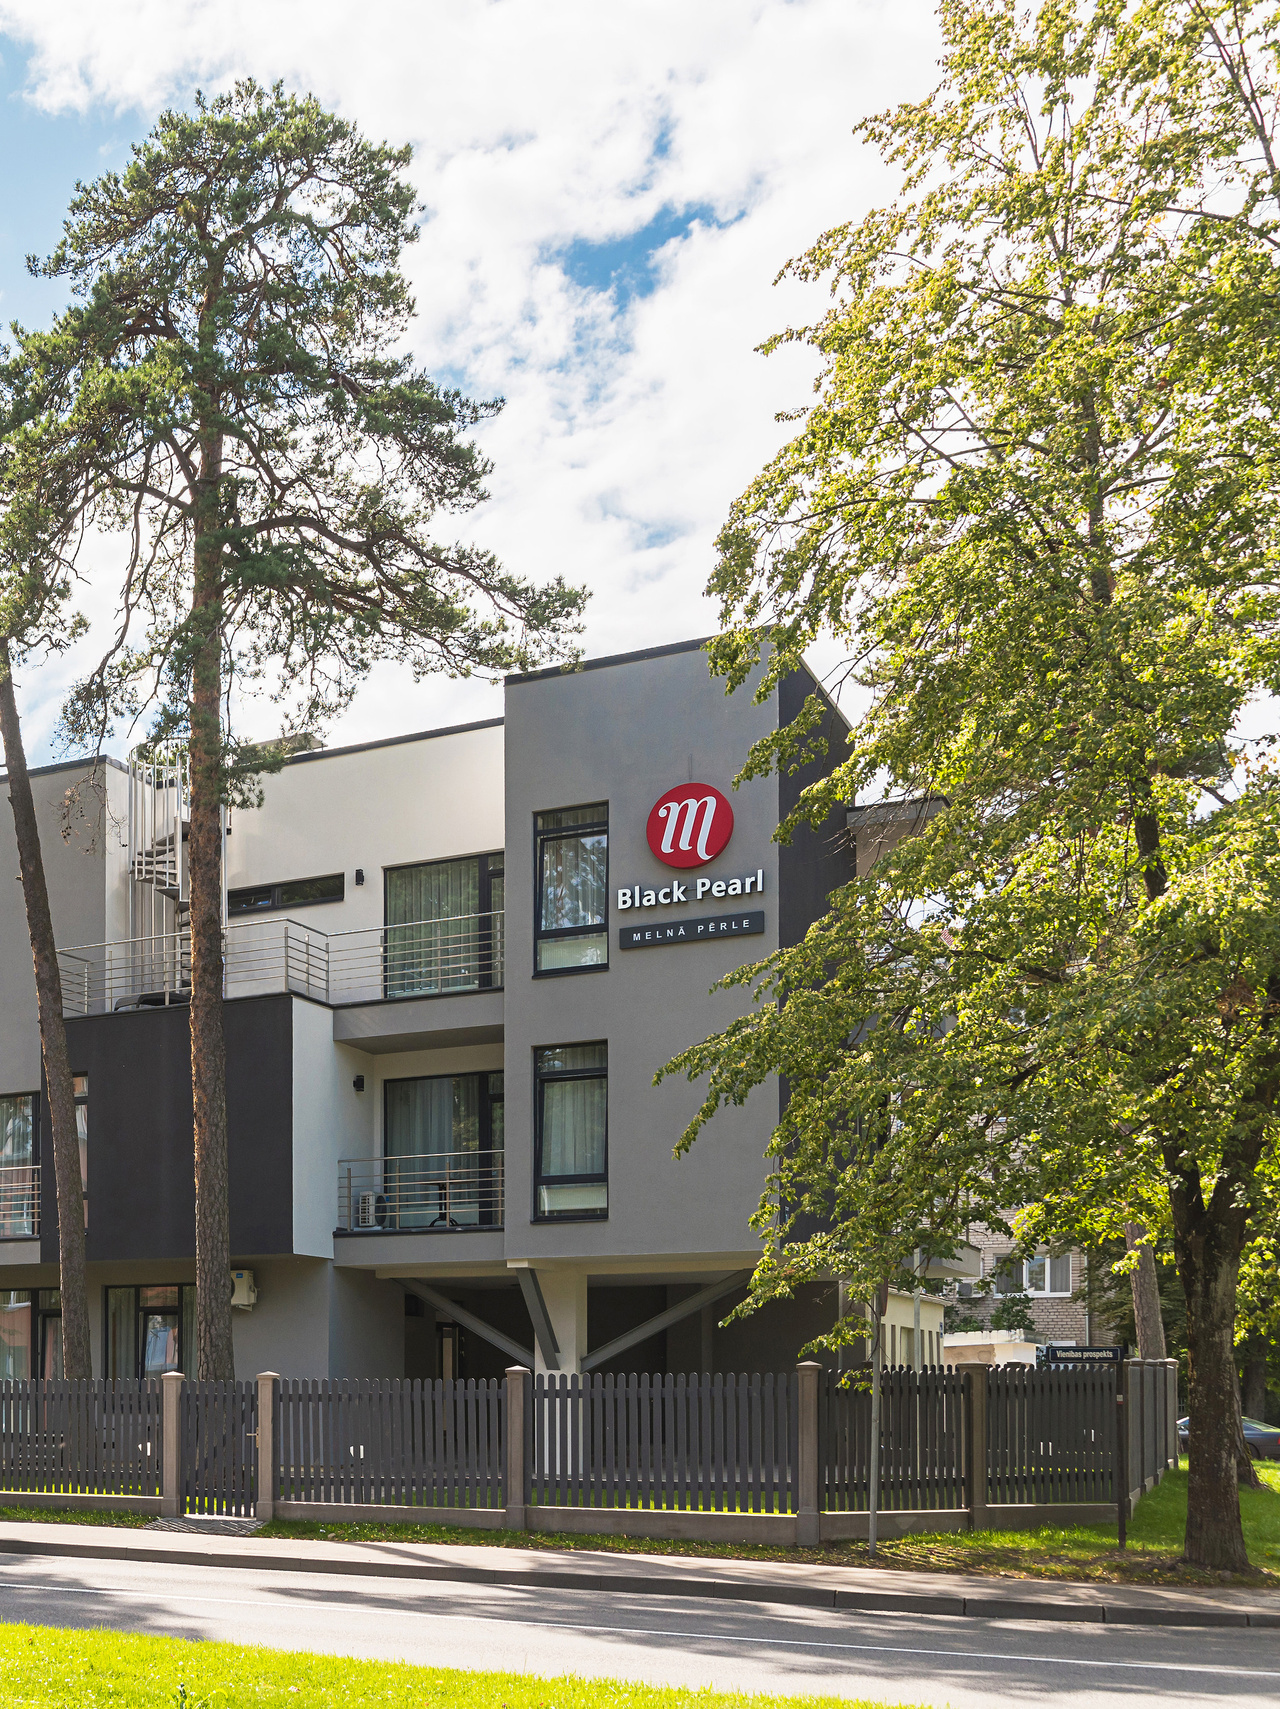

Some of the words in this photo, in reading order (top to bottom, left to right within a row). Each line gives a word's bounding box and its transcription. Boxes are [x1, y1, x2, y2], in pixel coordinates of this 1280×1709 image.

[617, 880, 687, 910] Black
[696, 869, 763, 900] Pearl
[632, 926, 686, 942] MELNĀ
[697, 919, 750, 934] PĒRLE
[1083, 1350, 1113, 1359] prospekts
